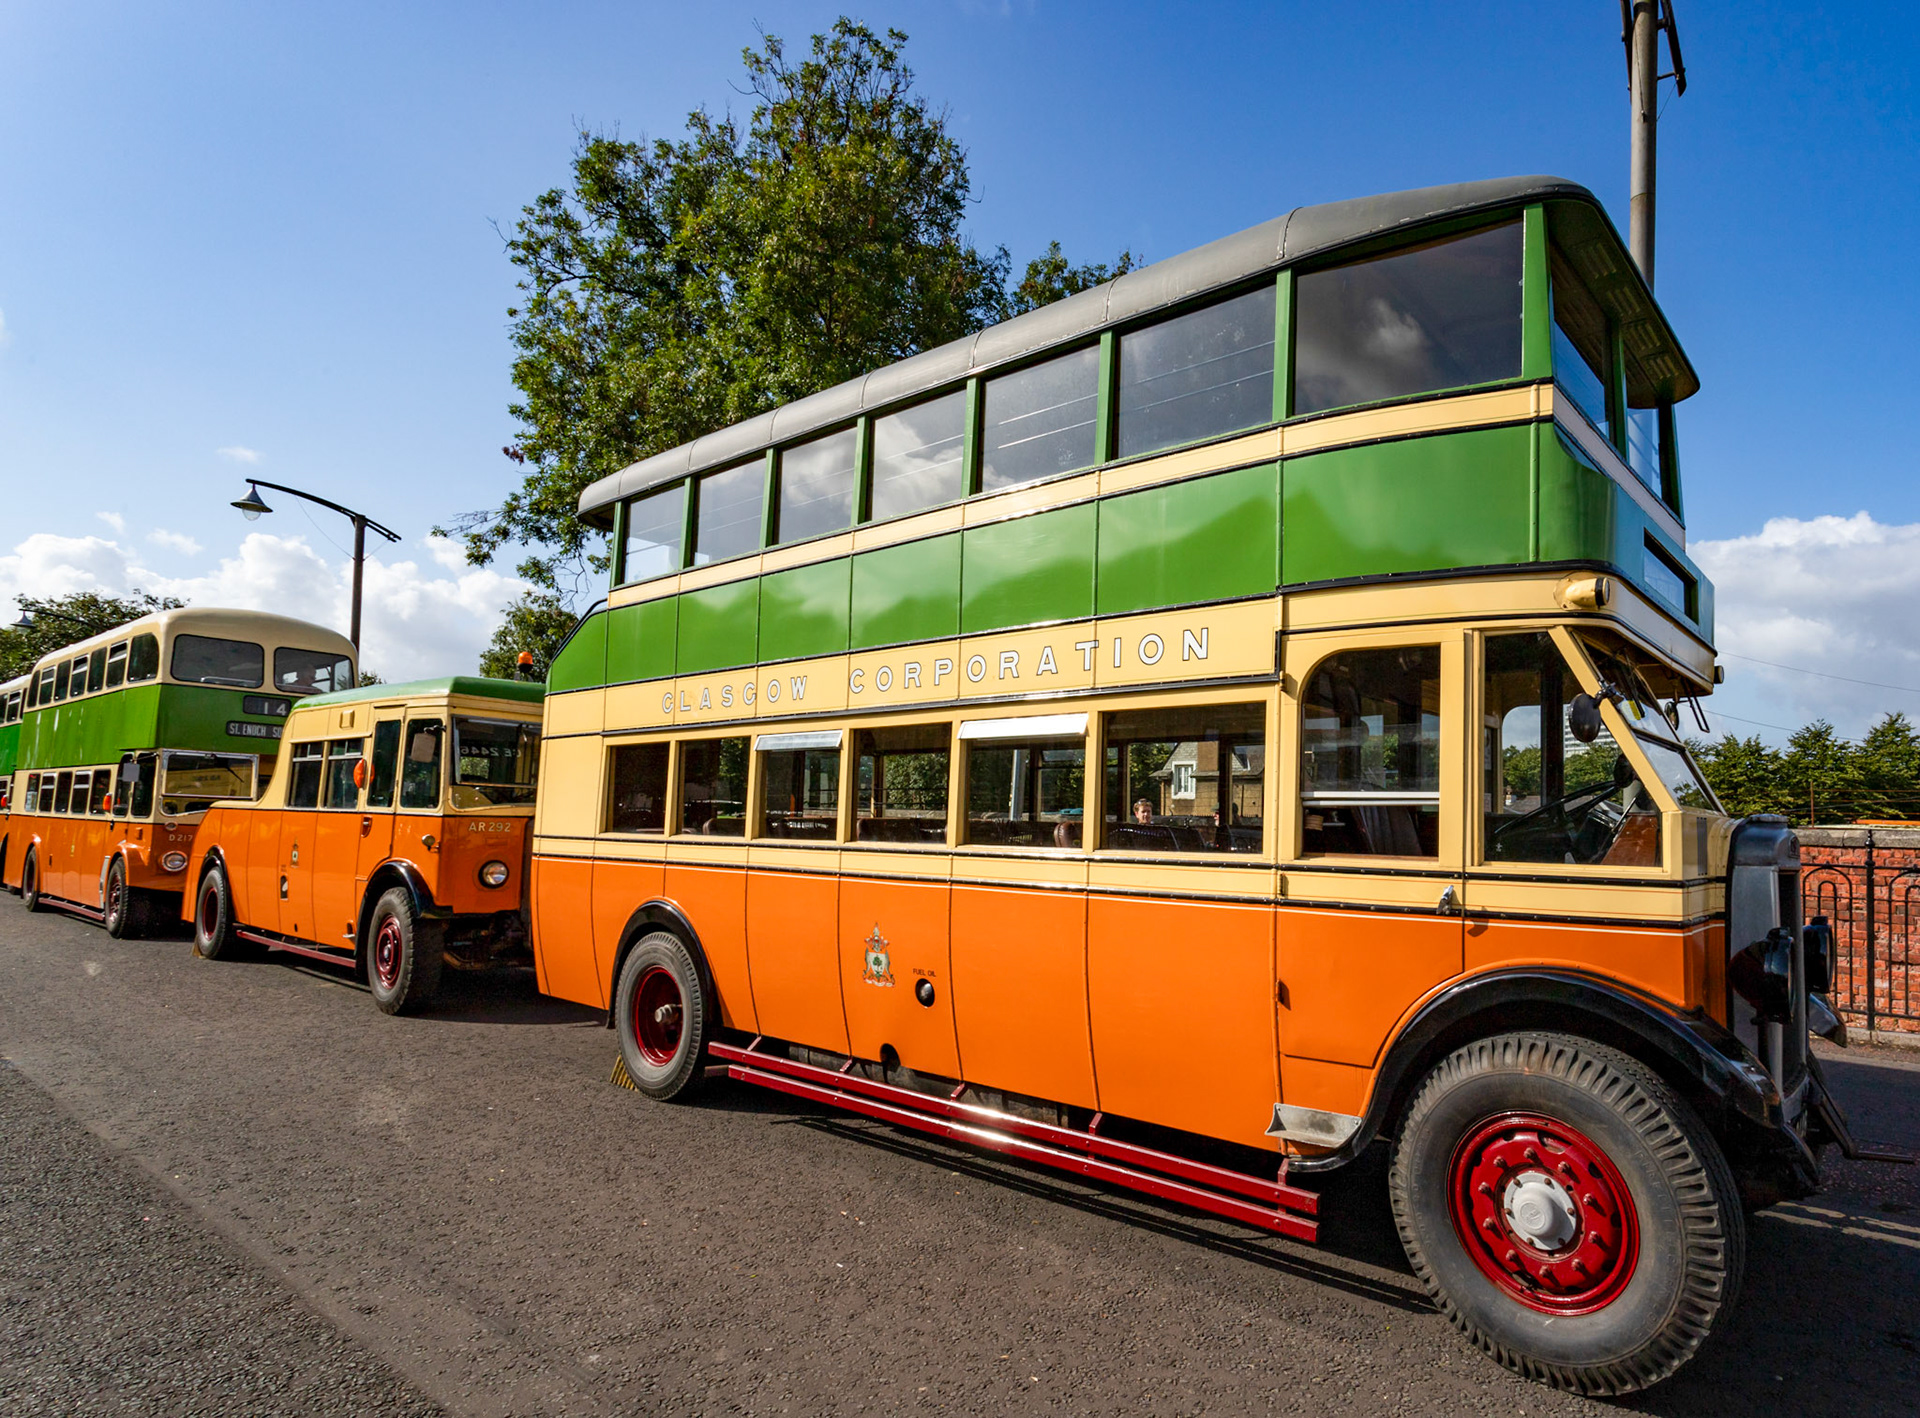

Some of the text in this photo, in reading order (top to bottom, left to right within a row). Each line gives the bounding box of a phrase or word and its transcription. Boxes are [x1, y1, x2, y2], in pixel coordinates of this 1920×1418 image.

[662, 627, 1209, 713] GLASGOW CORPORATION
[264, 702, 286, 716] 14
[230, 723, 240, 735] ST.
[242, 724, 267, 736] ENOCH
[468, 821, 511, 832] AR292
[913, 968, 926, 976] FUEL
